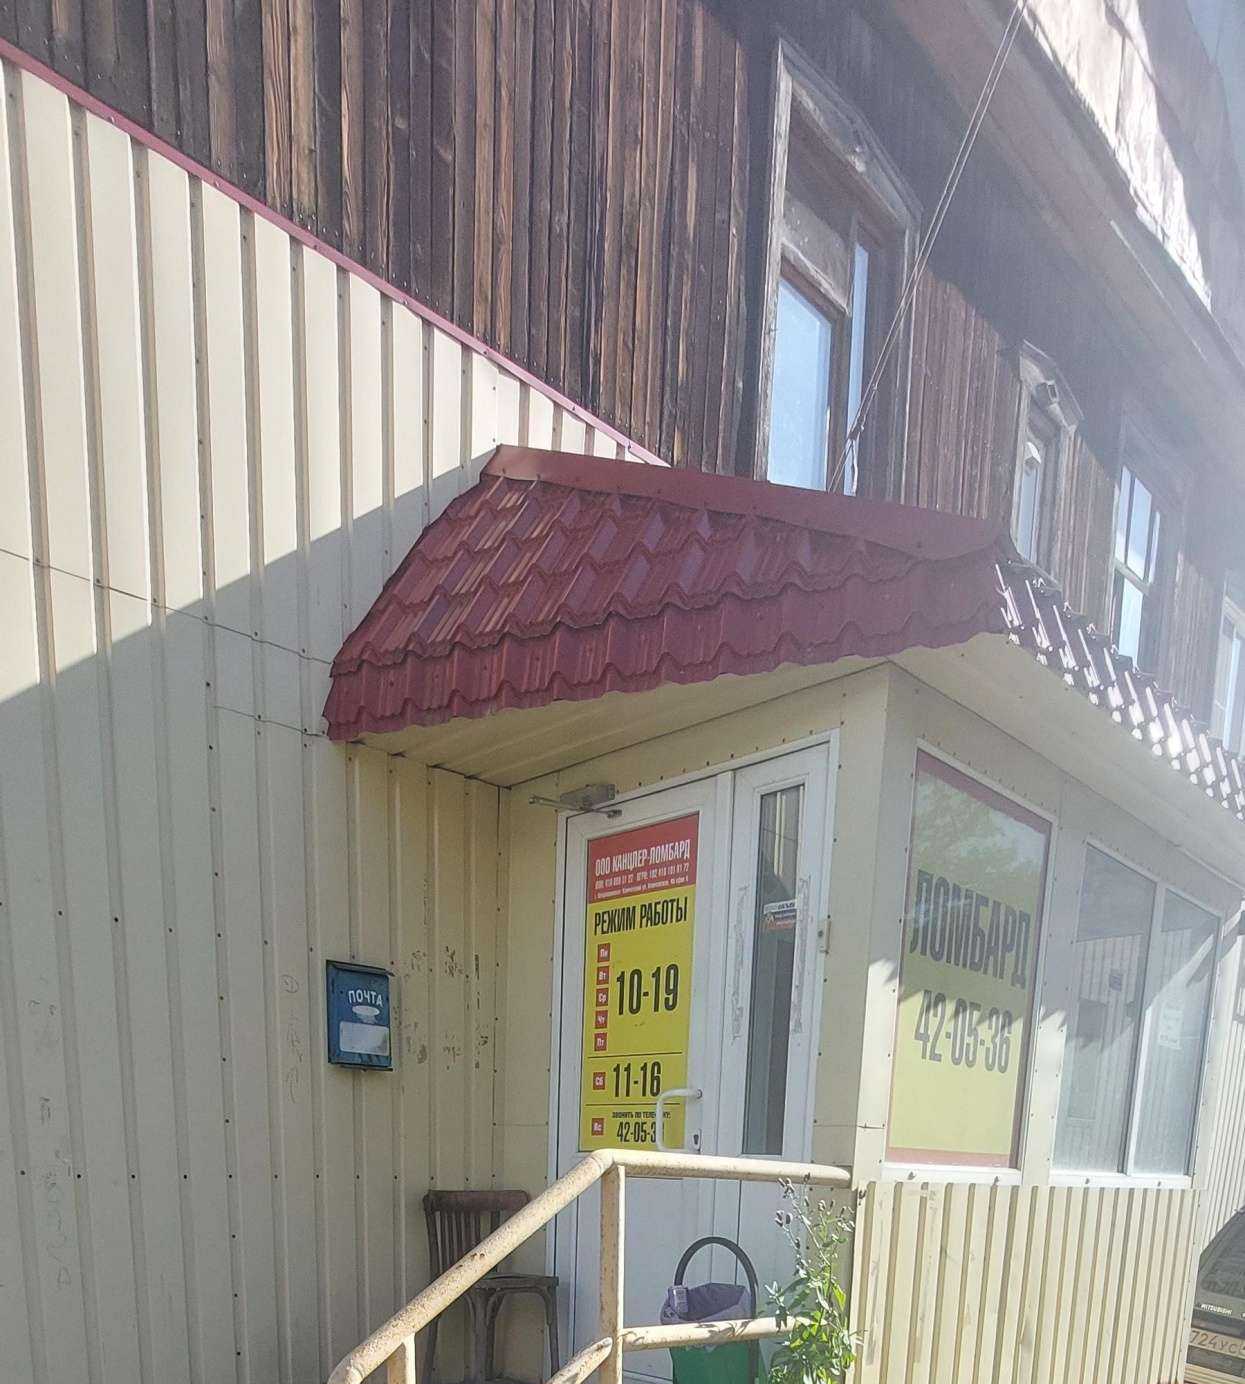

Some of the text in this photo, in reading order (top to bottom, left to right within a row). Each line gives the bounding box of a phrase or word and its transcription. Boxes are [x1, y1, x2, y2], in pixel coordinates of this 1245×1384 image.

[595, 856, 611, 877] ООО
[612, 839, 691, 873] КАНЦЛЕР-ЛОМБАРД
[594, 896, 688, 936] РЕЖИМ РАБОТЫ
[910, 869, 1031, 990] ЛОМБАРД
[348, 988, 384, 1008] ПОЧТА
[616, 963, 679, 1016] 10-19
[914, 989, 1013, 1074] 42-05-36
[613, 1061, 662, 1098] 11-16
[616, 1121, 665, 1144] 42-05-3
